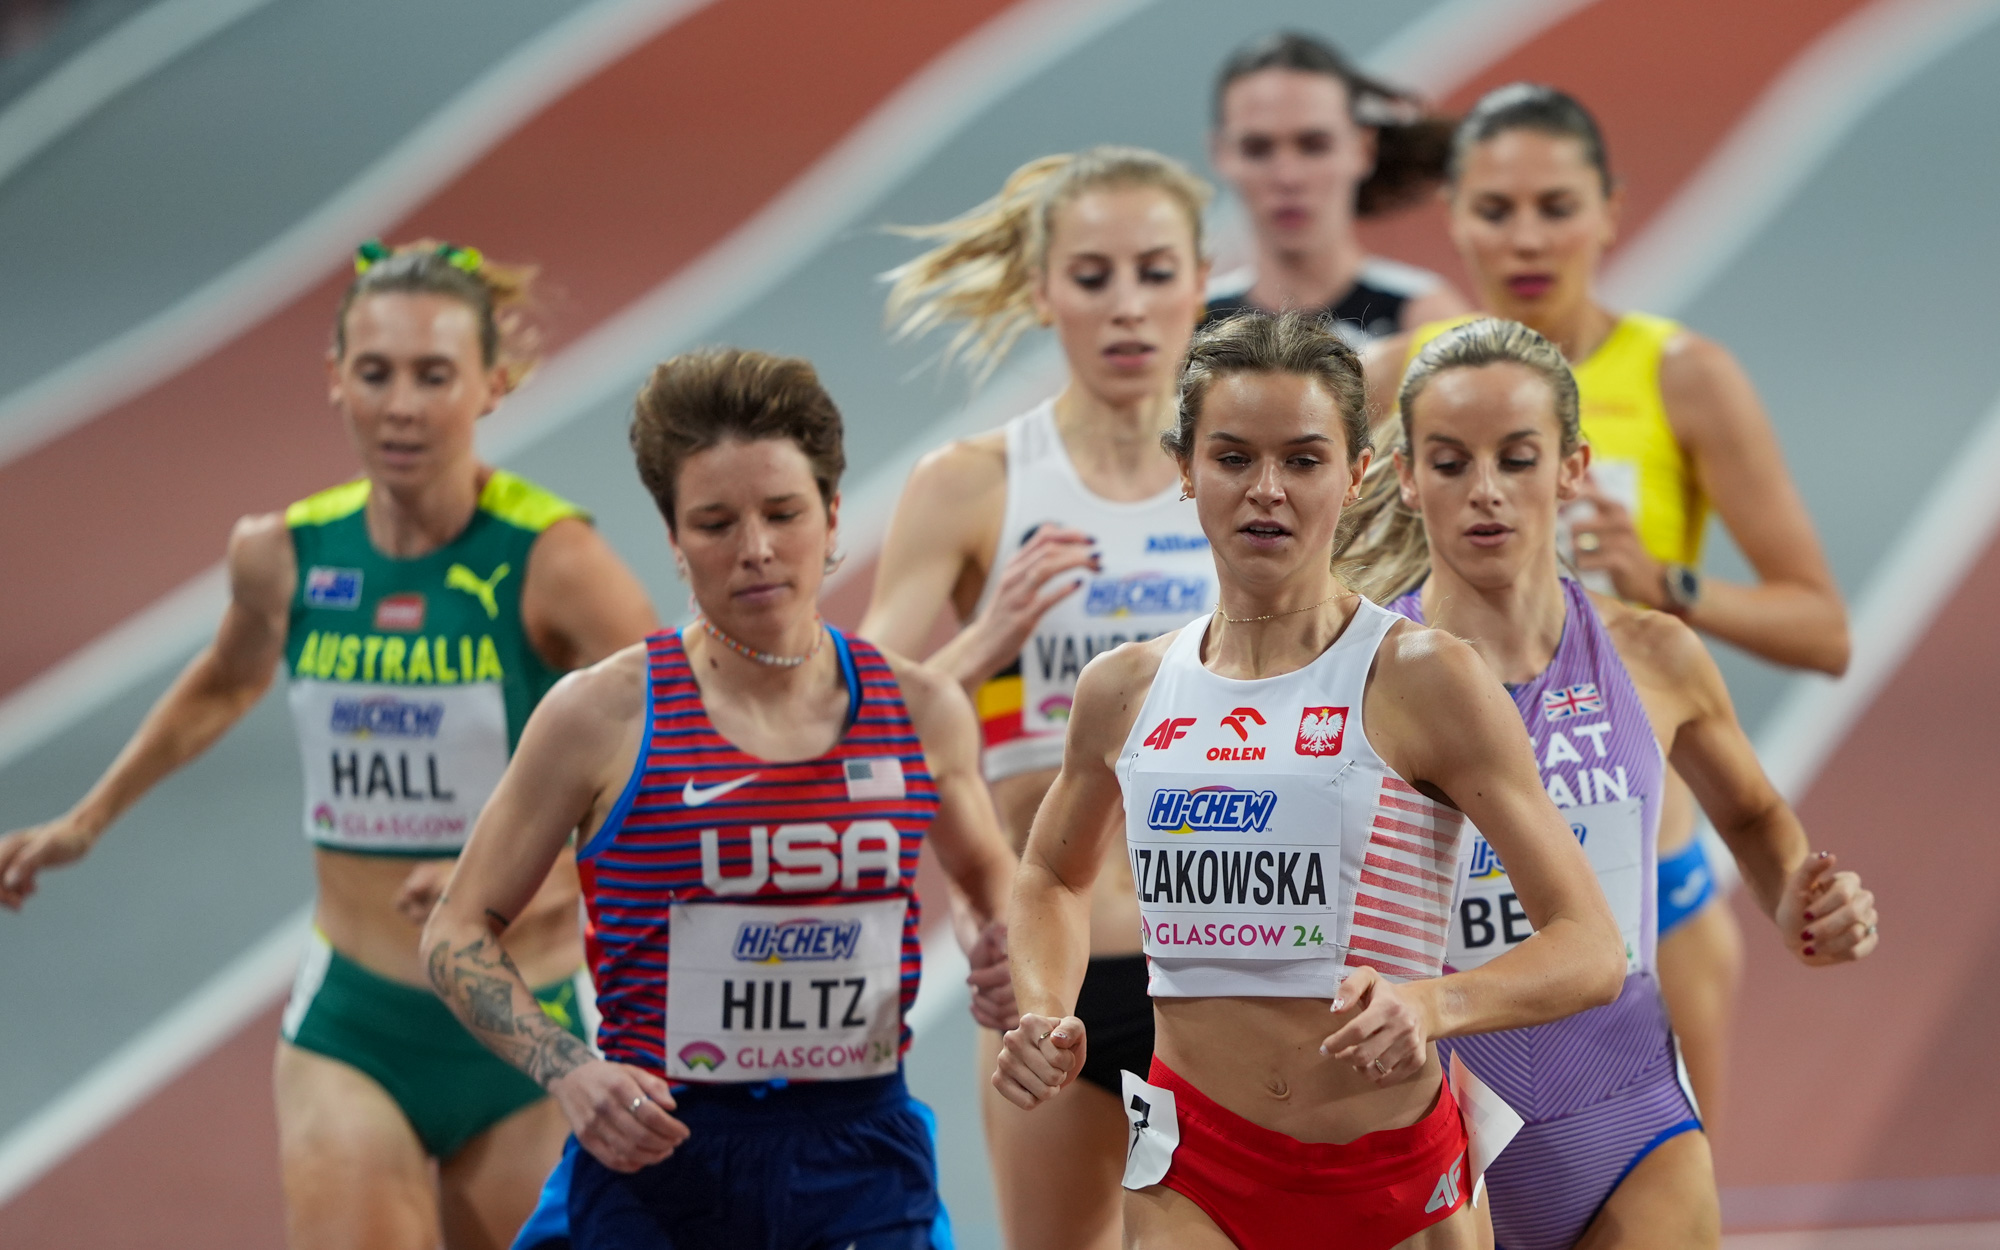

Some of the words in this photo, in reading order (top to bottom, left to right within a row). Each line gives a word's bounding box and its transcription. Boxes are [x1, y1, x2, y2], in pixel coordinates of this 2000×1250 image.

[296, 629, 503, 684] AUSTRALIA
[1143, 717, 1197, 750] 4F
[1206, 746, 1267, 761] ORLEN
[1530, 721, 1612, 769] AT
[331, 750, 457, 801] HALL
[1147, 788, 1278, 834] HI-CHEW
[700, 820, 900, 895] USA
[733, 918, 862, 962] HI-CHEW
[1156, 922, 1287, 947] GLASGOW
[1292, 924, 1324, 947] 24
[721, 977, 867, 1030] HILTZ
[737, 1042, 869, 1069] GLASGOW
